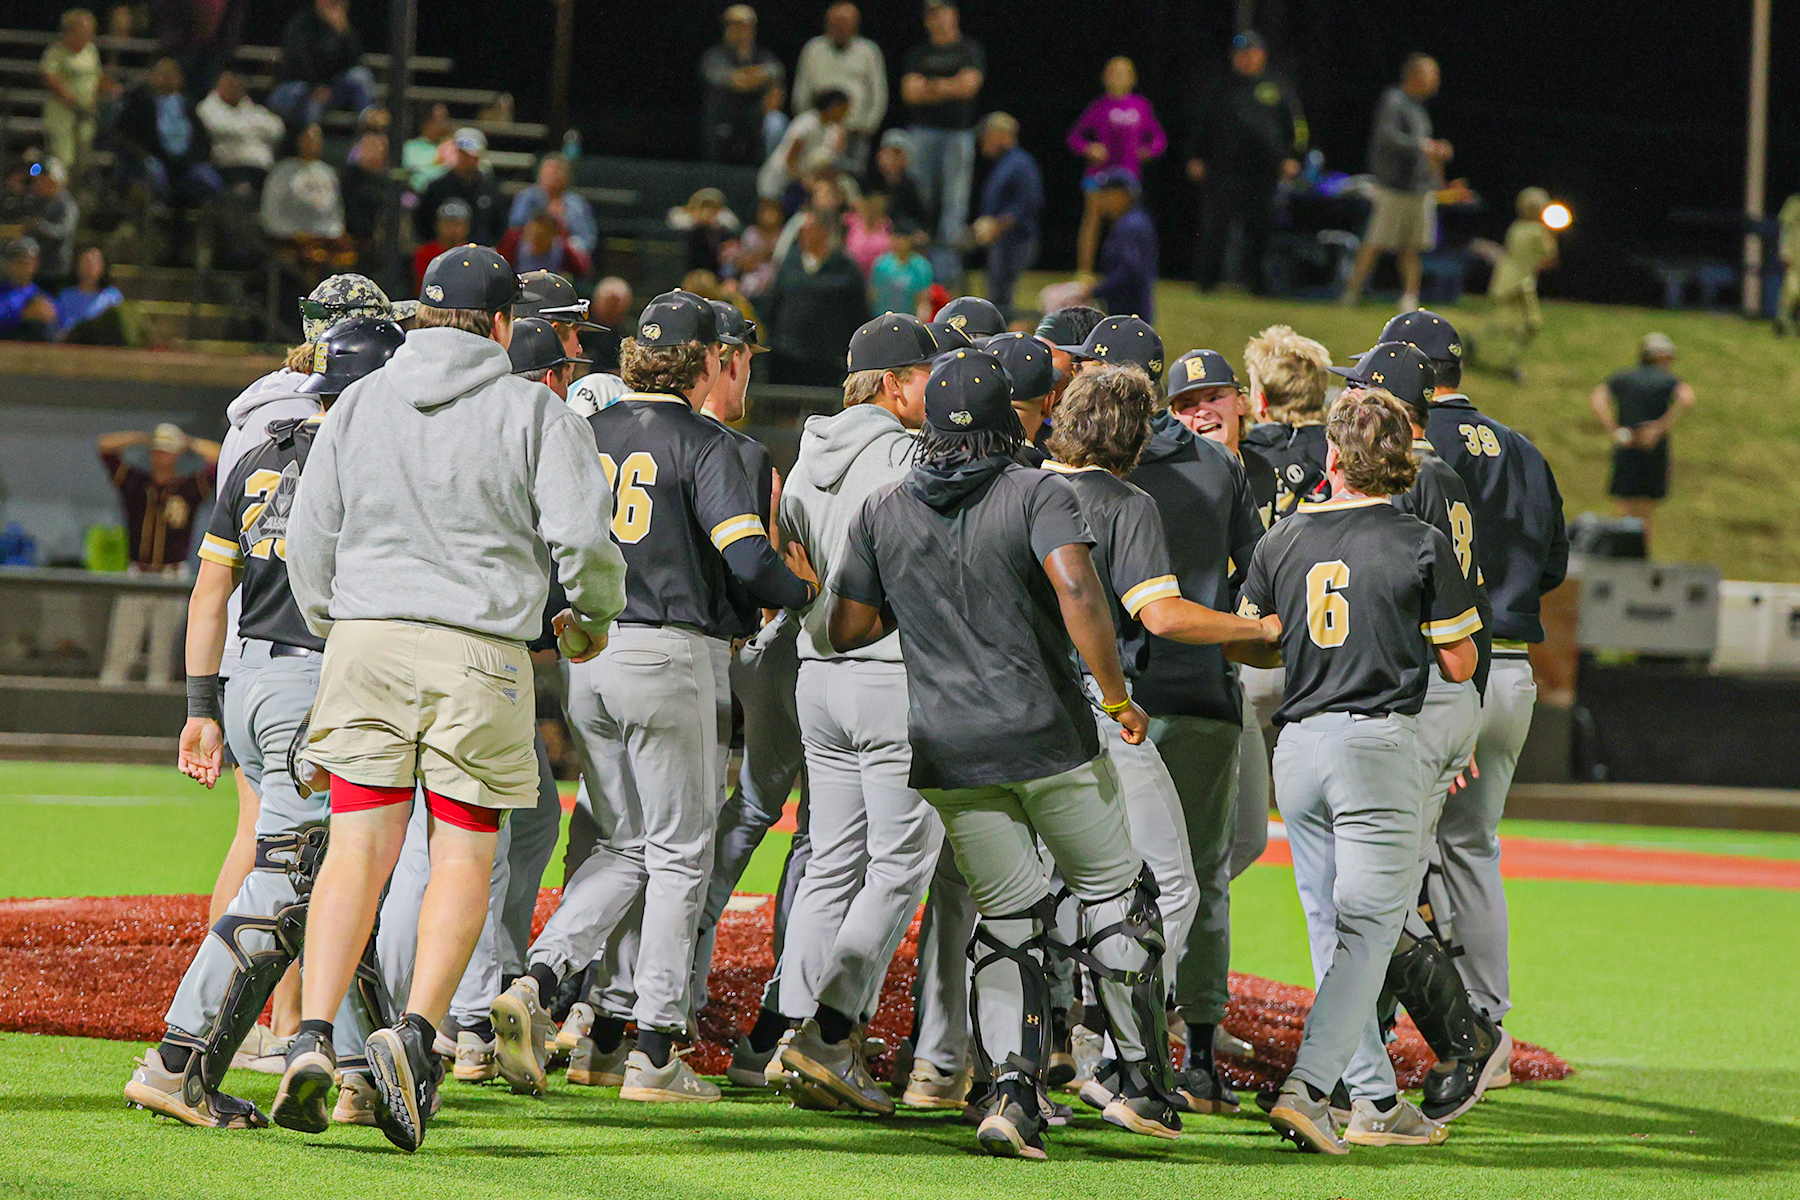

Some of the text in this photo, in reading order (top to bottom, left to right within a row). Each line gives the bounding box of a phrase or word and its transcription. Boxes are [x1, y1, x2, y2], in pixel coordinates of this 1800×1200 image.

[1458, 424, 1501, 457] 39
[240, 468, 289, 562] 2
[598, 452, 658, 544] 6
[1445, 498, 1473, 580] 8
[1306, 559, 1350, 649] 6
